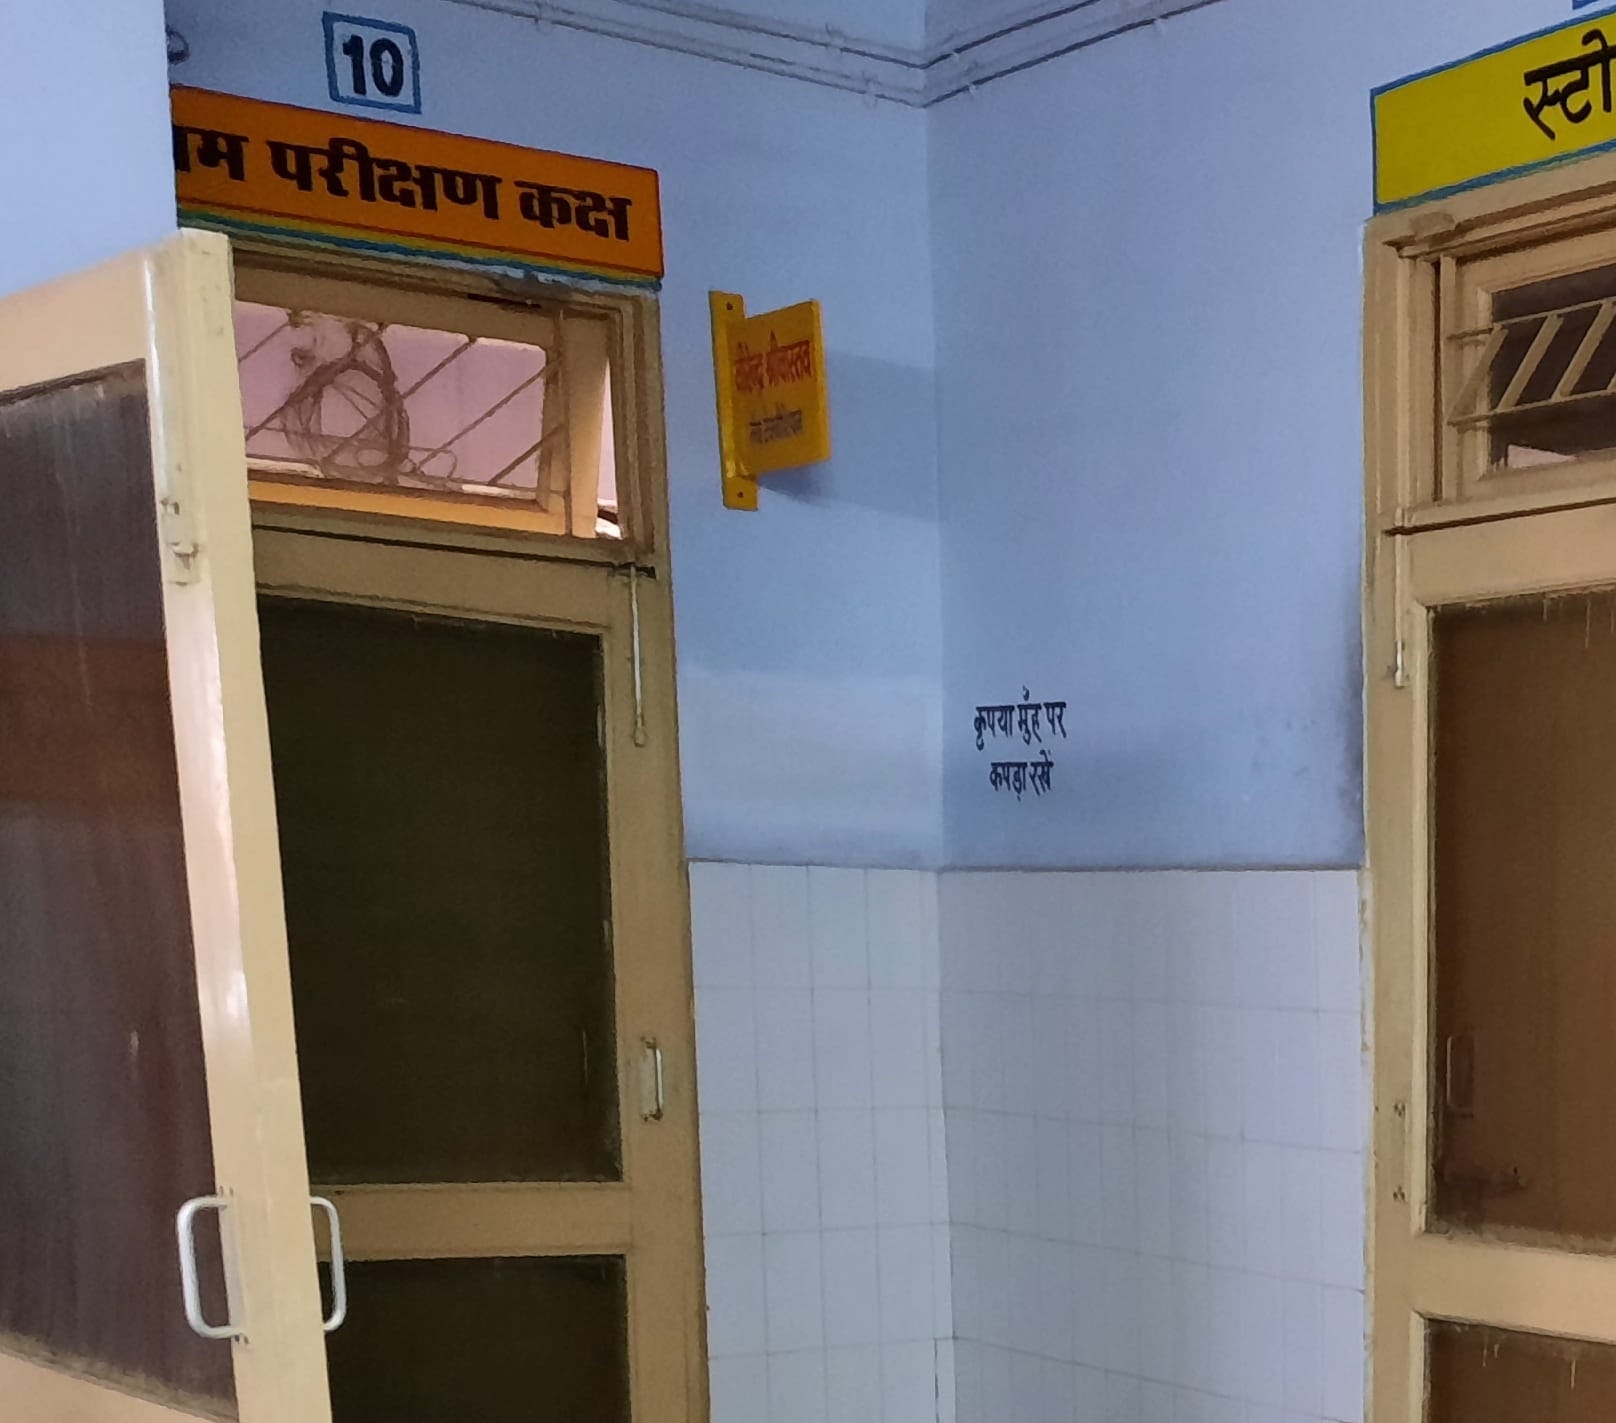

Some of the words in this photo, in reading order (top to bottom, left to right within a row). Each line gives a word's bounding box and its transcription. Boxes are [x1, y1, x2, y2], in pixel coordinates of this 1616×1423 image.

[342, 33, 403, 98] 10
[266, 137, 500, 221] परीक्षण
[514, 179, 632, 240] कक्ष
[1043, 701, 1067, 738] पर
[989, 761, 1028, 802] कपड़ा
